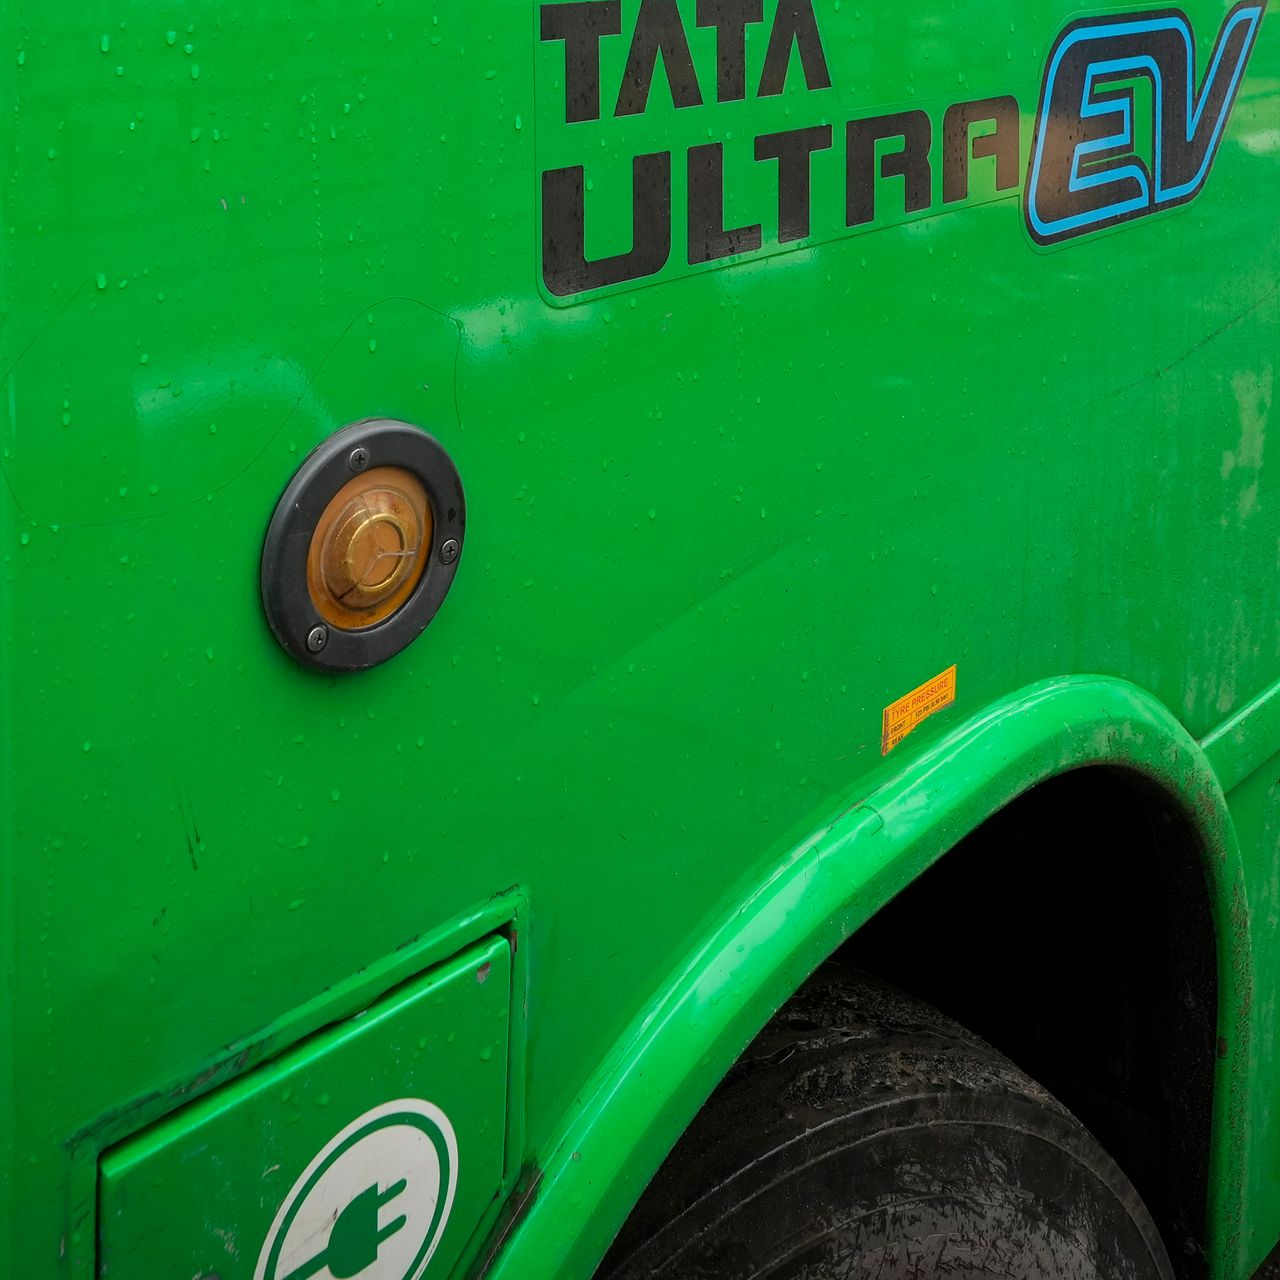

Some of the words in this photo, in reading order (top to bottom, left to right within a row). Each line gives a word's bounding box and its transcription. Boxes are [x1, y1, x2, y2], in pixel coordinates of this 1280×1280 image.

[541, 94, 1021, 297] ULTRA
[891, 703, 910, 721] TYRE
[911, 678, 948, 707] PRESSURE
